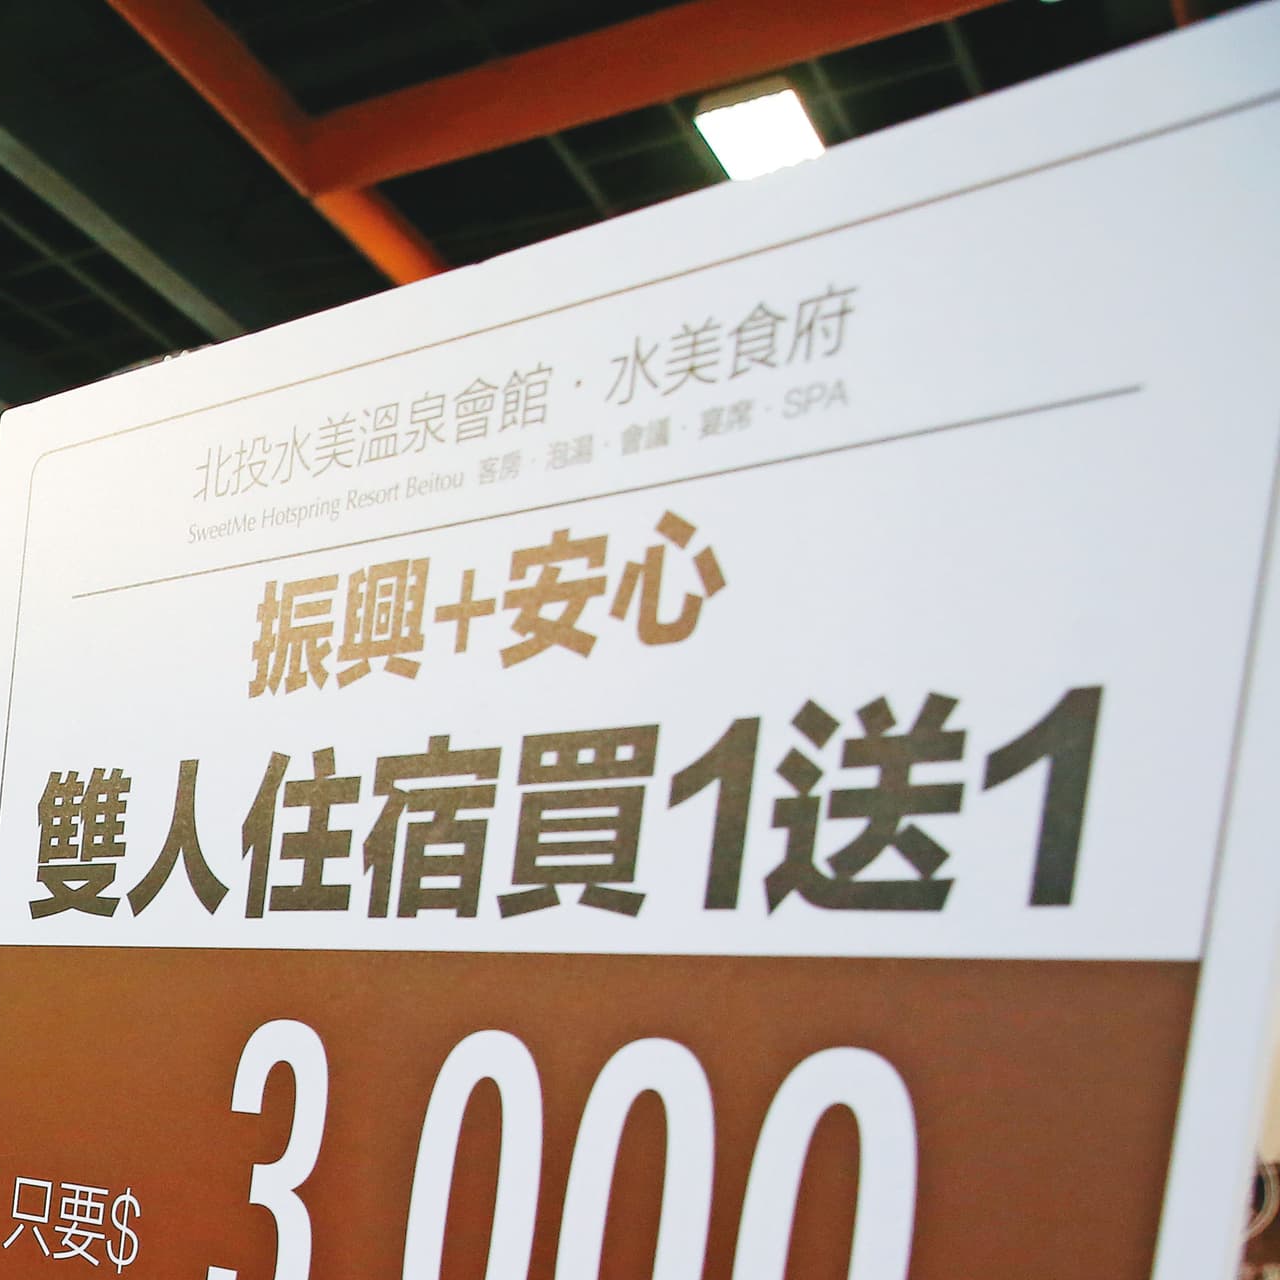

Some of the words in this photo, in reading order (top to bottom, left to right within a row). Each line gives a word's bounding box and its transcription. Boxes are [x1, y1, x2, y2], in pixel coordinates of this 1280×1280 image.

[261, 494, 341, 529] Hotspring
[345, 483, 400, 511] Resort
[405, 469, 465, 499] Beitou
[248, 511, 728, 698] 振興+安心
[28, 684, 1106, 920] 雙人住宿買1送1
